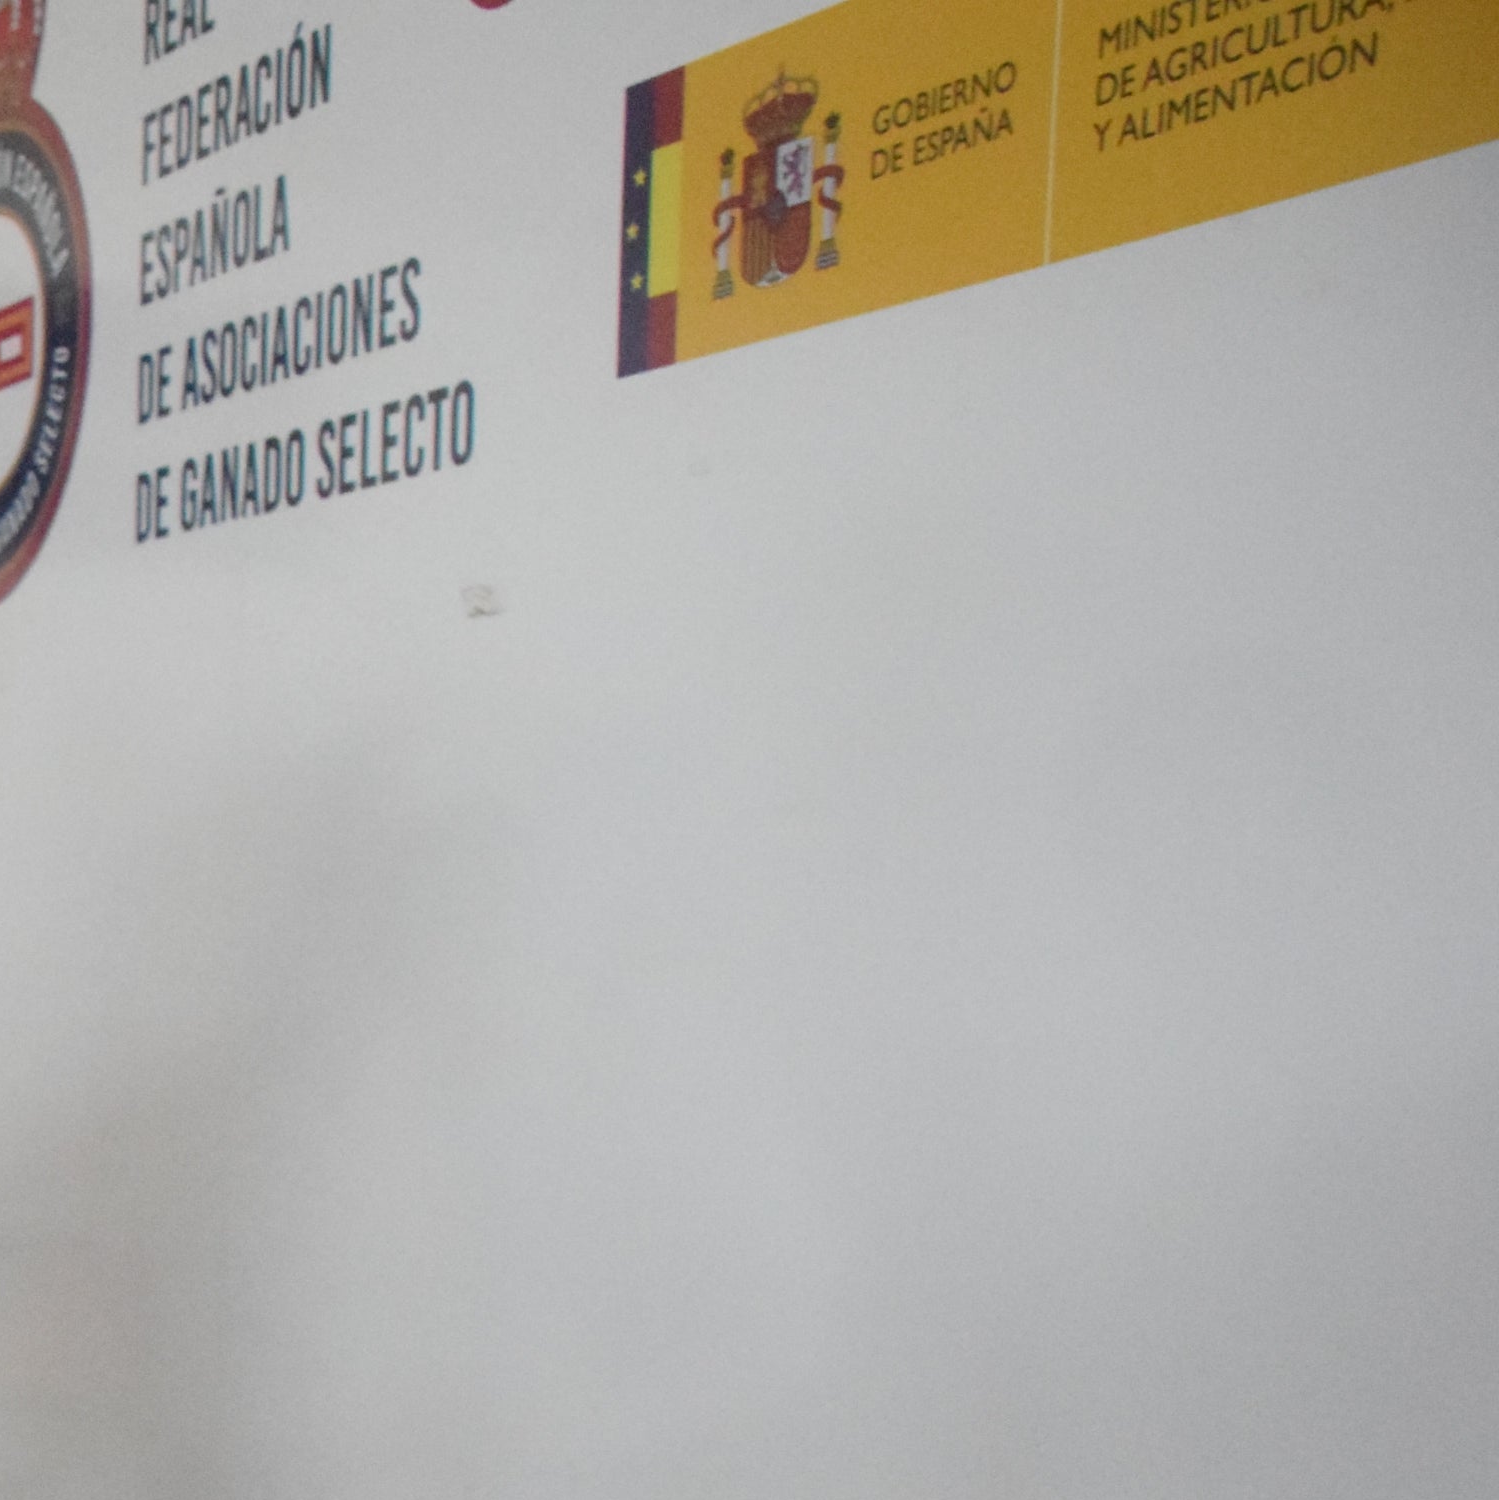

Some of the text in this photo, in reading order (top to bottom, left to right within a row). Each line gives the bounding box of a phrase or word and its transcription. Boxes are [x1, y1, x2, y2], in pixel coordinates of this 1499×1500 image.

[1096, 63, 1136, 107] DE
[1099, 0, 1271, 60] MINISTER
[141, 20, 332, 187] FEDERACIÓN
[870, 106, 1014, 181] DE ESPAÑA
[872, 60, 1018, 136] GOBIERNO
[1093, 31, 1379, 153] Y ALIMENTACIÓN
[139, 173, 291, 307] ESPAÑOLA
[136, 255, 422, 426] DE ASOCIACIONES
[135, 465, 172, 545] DE
[179, 427, 307, 533] GANADO
[315, 378, 477, 500] SELECTO
